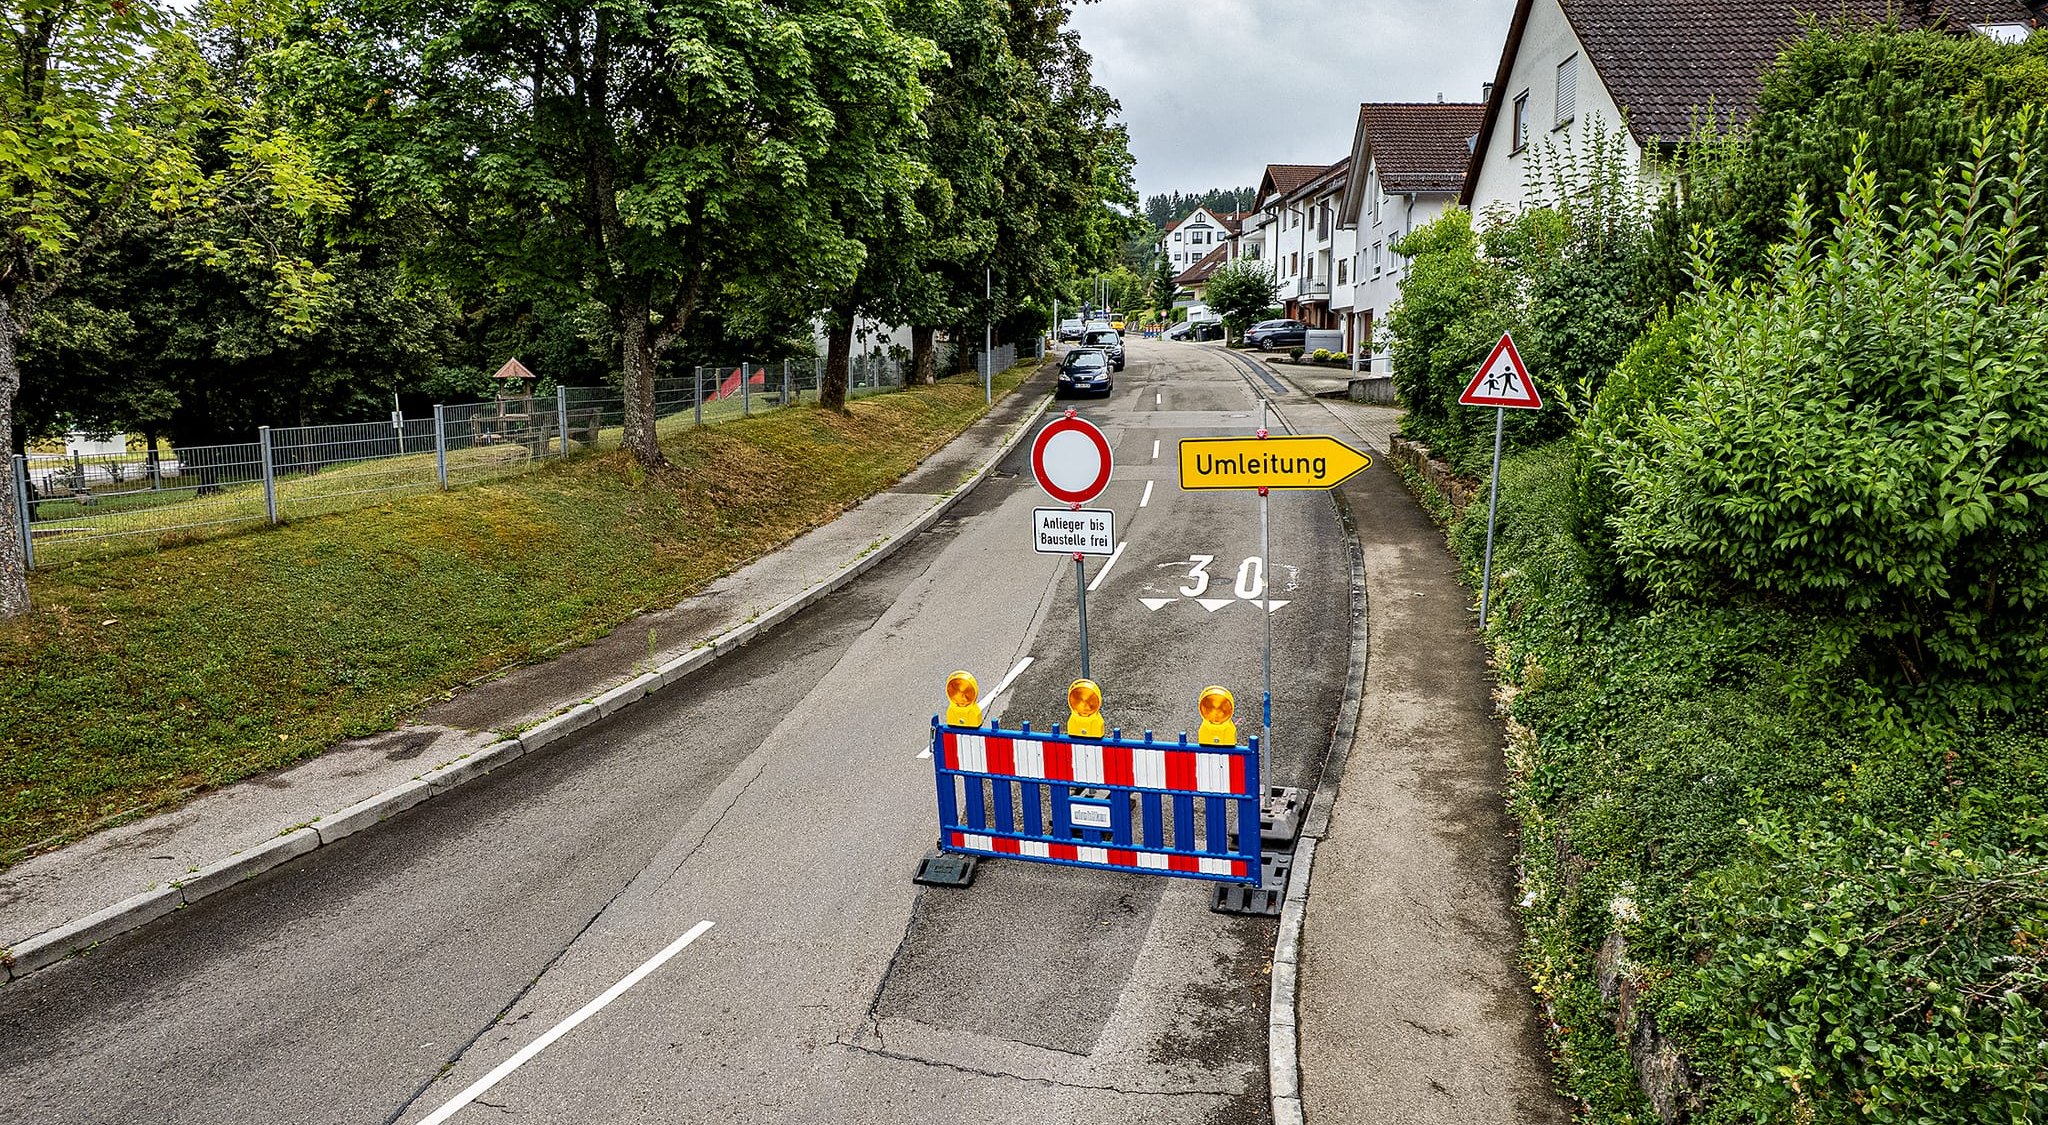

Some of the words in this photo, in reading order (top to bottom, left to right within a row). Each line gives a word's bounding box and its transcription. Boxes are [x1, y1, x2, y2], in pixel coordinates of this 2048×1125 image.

[1196, 453, 1326, 479] Umleitung
[1043, 517, 1085, 533] Anlieger
[1090, 518, 1105, 531] bis
[1041, 532, 1086, 546] Baustelle
[1090, 534, 1108, 547] frei
